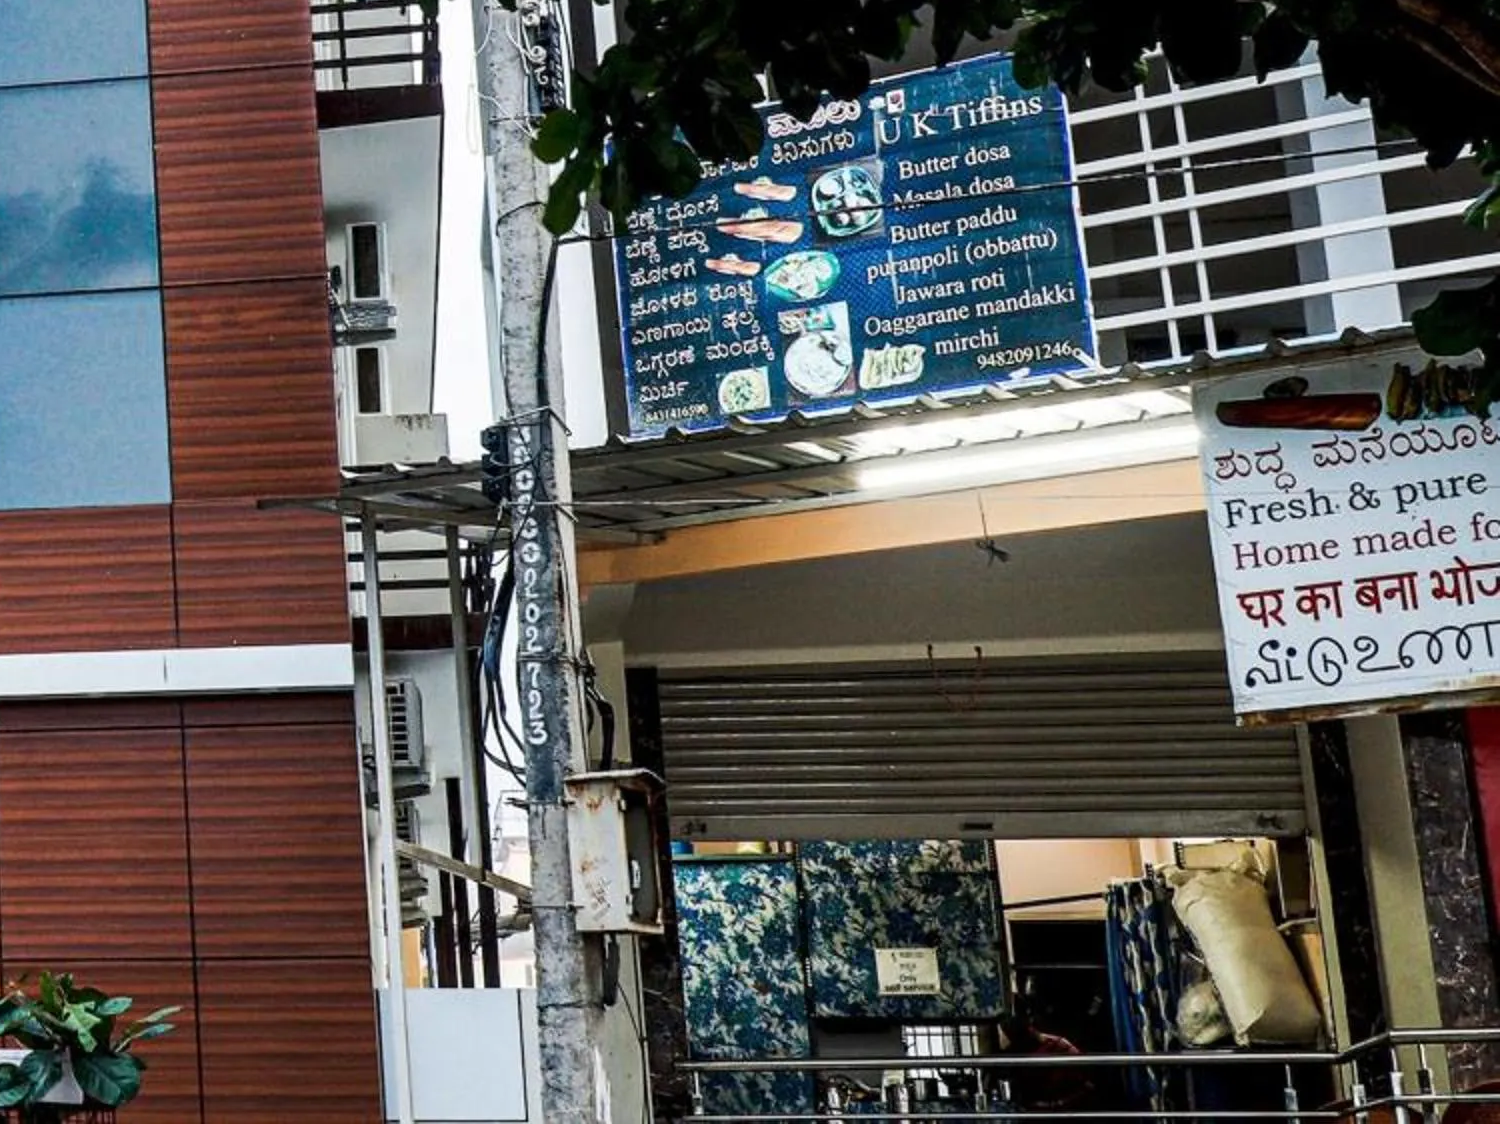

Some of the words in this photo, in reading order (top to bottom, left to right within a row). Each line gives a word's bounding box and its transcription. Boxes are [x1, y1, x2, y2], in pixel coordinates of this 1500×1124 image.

[879, 117, 901, 145] U
[911, 110, 939, 139] K
[951, 93, 1044, 131] Tiffins
[899, 154, 959, 180] Butter
[965, 144, 1012, 166] dosa
[893, 182, 964, 210] Masala
[969, 175, 1015, 195] dosa
[891, 218, 951, 244] Butter
[956, 205, 1017, 236] paddu
[867, 244, 959, 284] puranpoli
[965, 227, 1057, 265] (obbattu)
[897, 280, 965, 305] Jawara
[971, 267, 1006, 290] roti
[864, 304, 970, 336] Oaggarane
[975, 282, 1076, 317] mandakki
[935, 326, 1000, 355] mirchi
[977, 340, 1072, 369] 9482091246
[1223, 487, 1335, 528] Fresh
[1348, 481, 1381, 512] &
[1394, 472, 1488, 513] pure
[1232, 539, 1340, 570] Home
[1352, 519, 1457, 556] made
[1236, 589, 1287, 628] घर
[1294, 580, 1343, 622] का
[1354, 571, 1419, 614] बना
